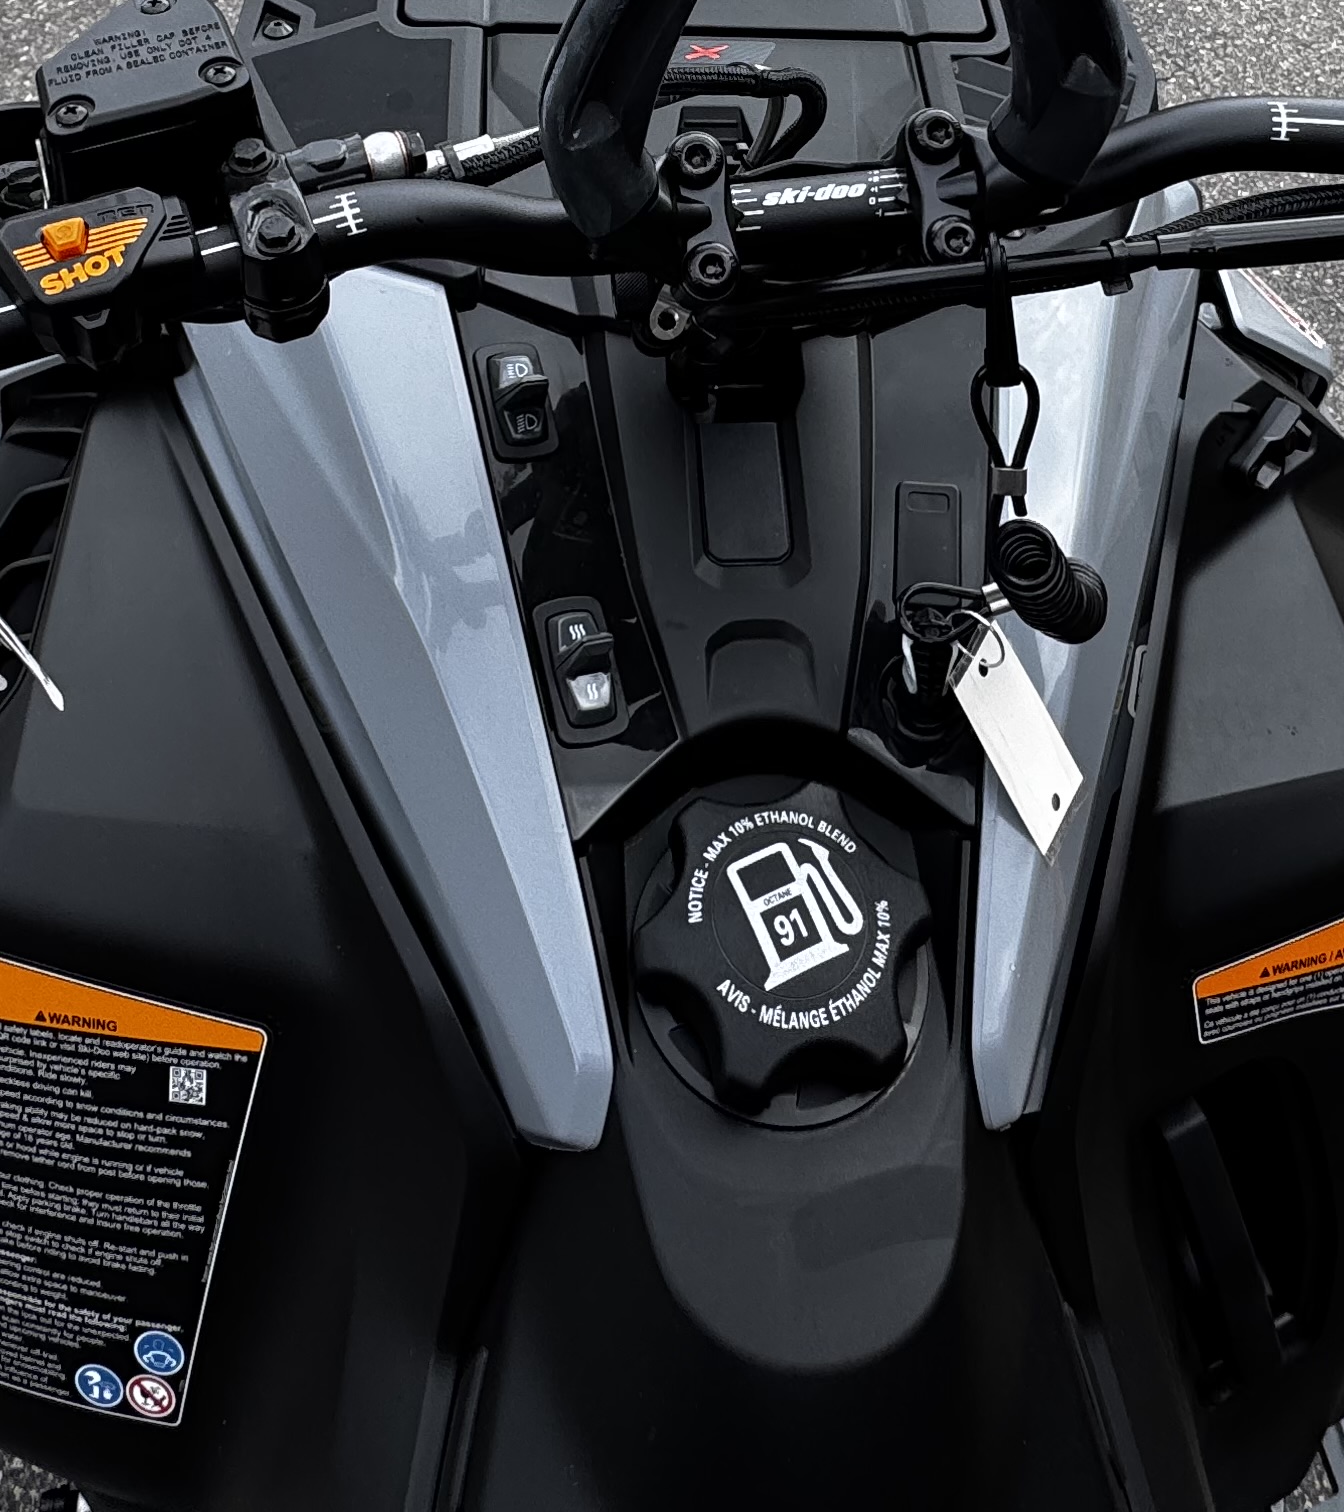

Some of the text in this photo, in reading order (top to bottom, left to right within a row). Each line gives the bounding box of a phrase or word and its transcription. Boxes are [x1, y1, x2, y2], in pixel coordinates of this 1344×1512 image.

[71, 22, 221, 62] CLEAN FILLER CAP BEFORE
[121, 50, 141, 61] USE
[147, 42, 173, 56] ONLY
[179, 36, 198, 48] DOT
[205, 33, 212, 42] 4
[48, 40, 228, 88] FLUID FROM A SEALED CONTAINER
[762, 183, 867, 206] ski-doo
[40, 245, 126, 296] SHOT
[688, 868, 709, 924] NOTICE
[703, 831, 732, 862] MAX
[728, 817, 754, 837] 10%
[754, 810, 814, 829] ETHANOL
[817, 820, 857, 854] BLEND
[763, 887, 793, 906] OCTANE
[874, 899, 891, 928] 10%
[773, 908, 808, 946] 91
[871, 930, 891, 969] MAX
[1271, 953, 1327, 977] WARNING
[716, 979, 752, 1013] AVIS
[828, 966, 882, 1022] ÉTHANOL
[48, 1011, 117, 1032] WARNING
[758, 1004, 830, 1030] MÉLANGE
